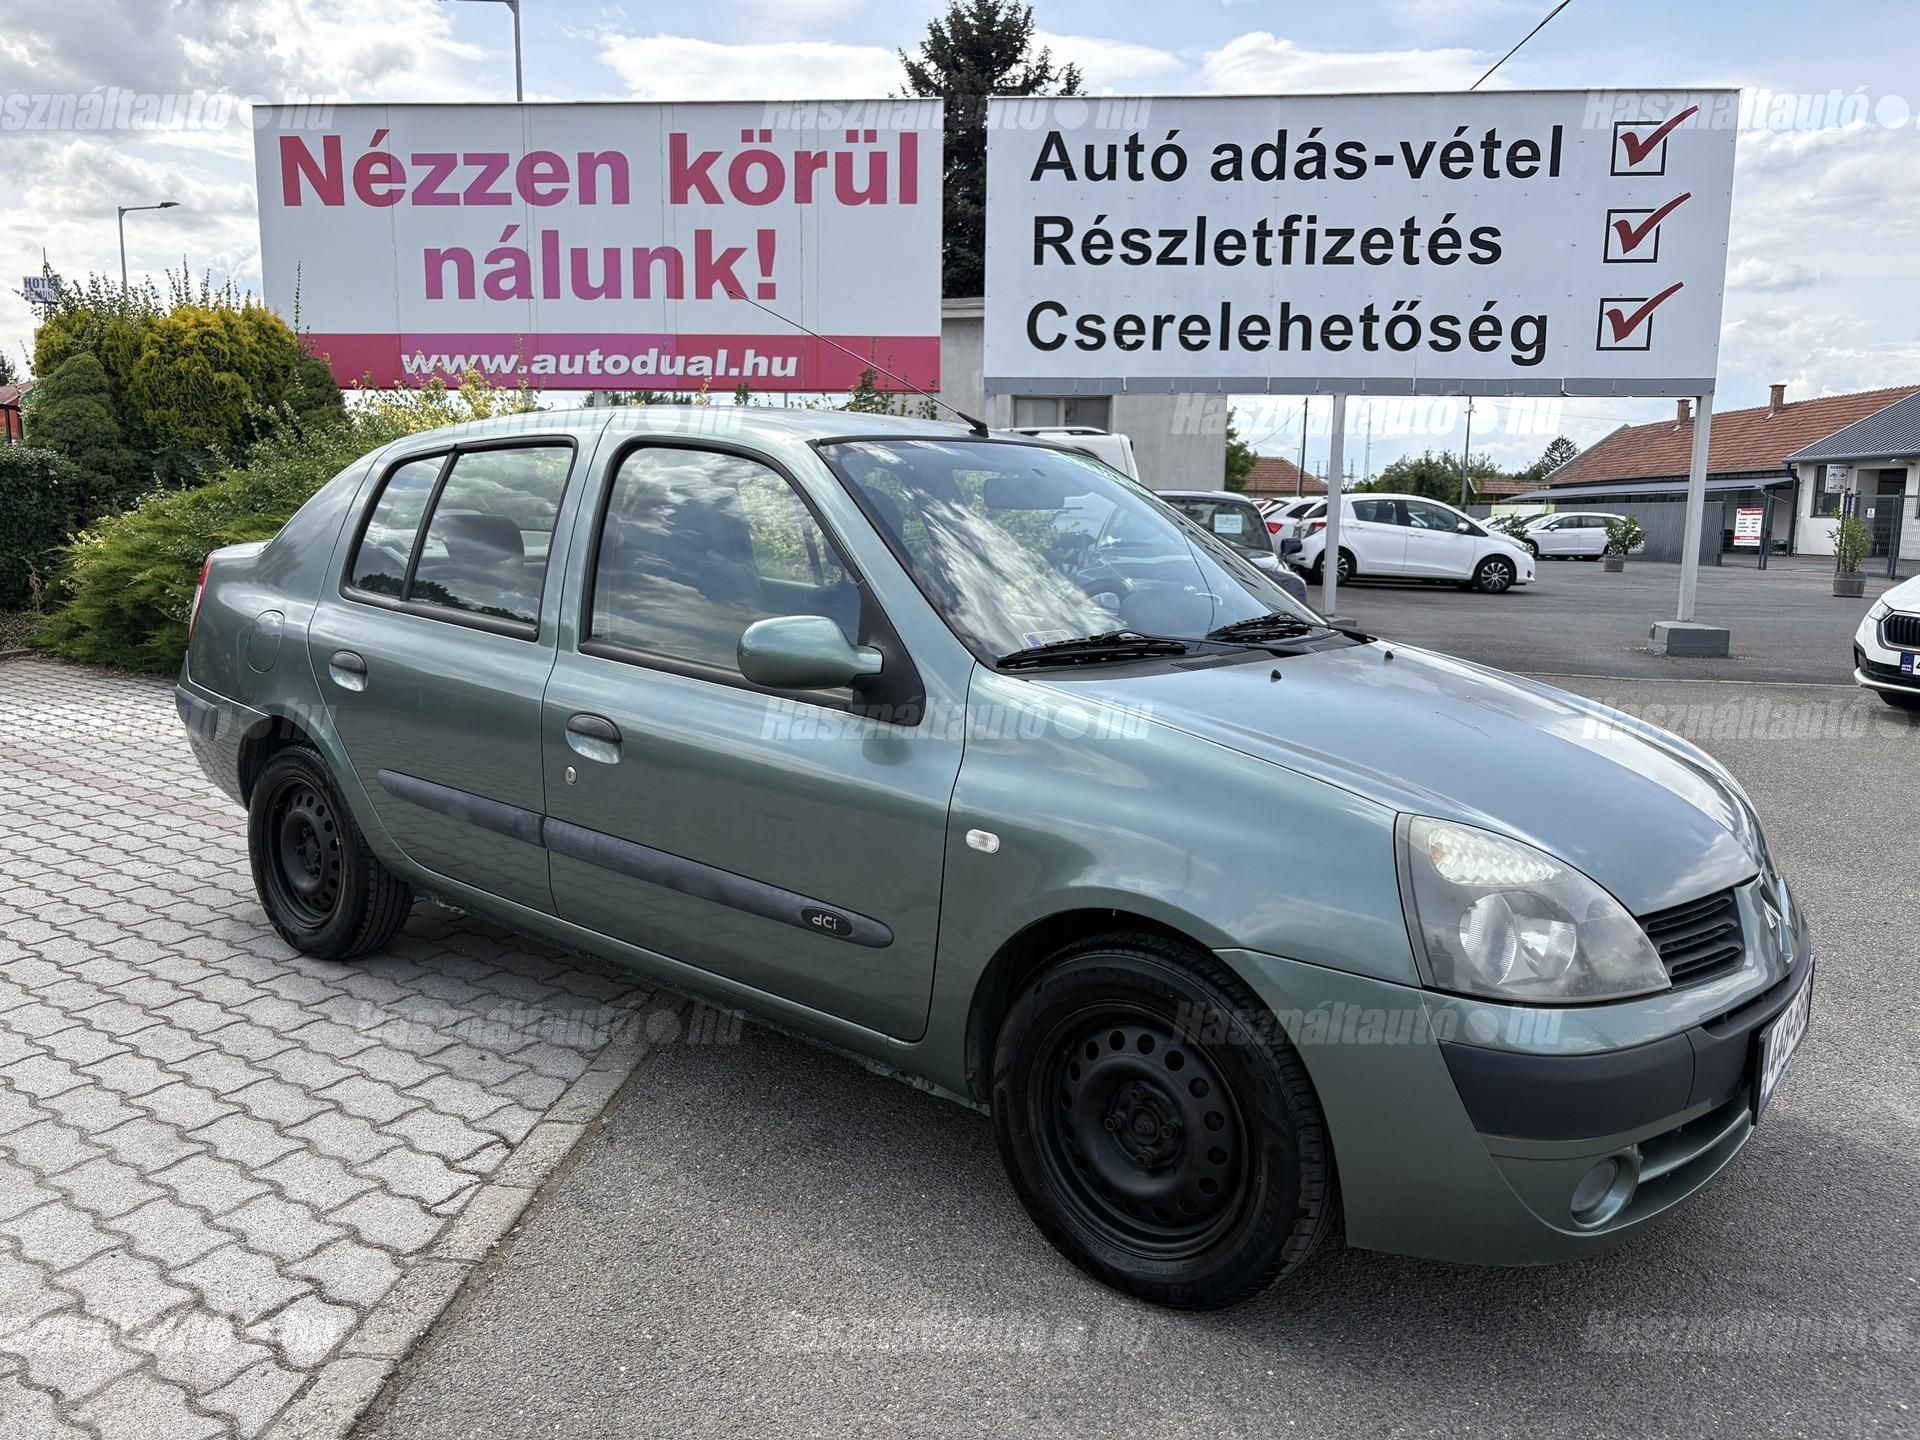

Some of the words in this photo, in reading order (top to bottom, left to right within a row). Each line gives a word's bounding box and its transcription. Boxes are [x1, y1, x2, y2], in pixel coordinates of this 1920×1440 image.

[280, 130, 628, 206] Nézzen
[670, 130, 918, 206] körül
[1030, 130, 1188, 182] Autó
[1210, 125, 1564, 182] adás-vétel
[424, 230, 776, 300] nálunk!
[1034, 213, 1502, 266] Részletfizetés
[401, 348, 798, 377] www.autodual.hu
[1027, 301, 1548, 367] Cserelehetőség
[811, 914, 837, 931] dCi
